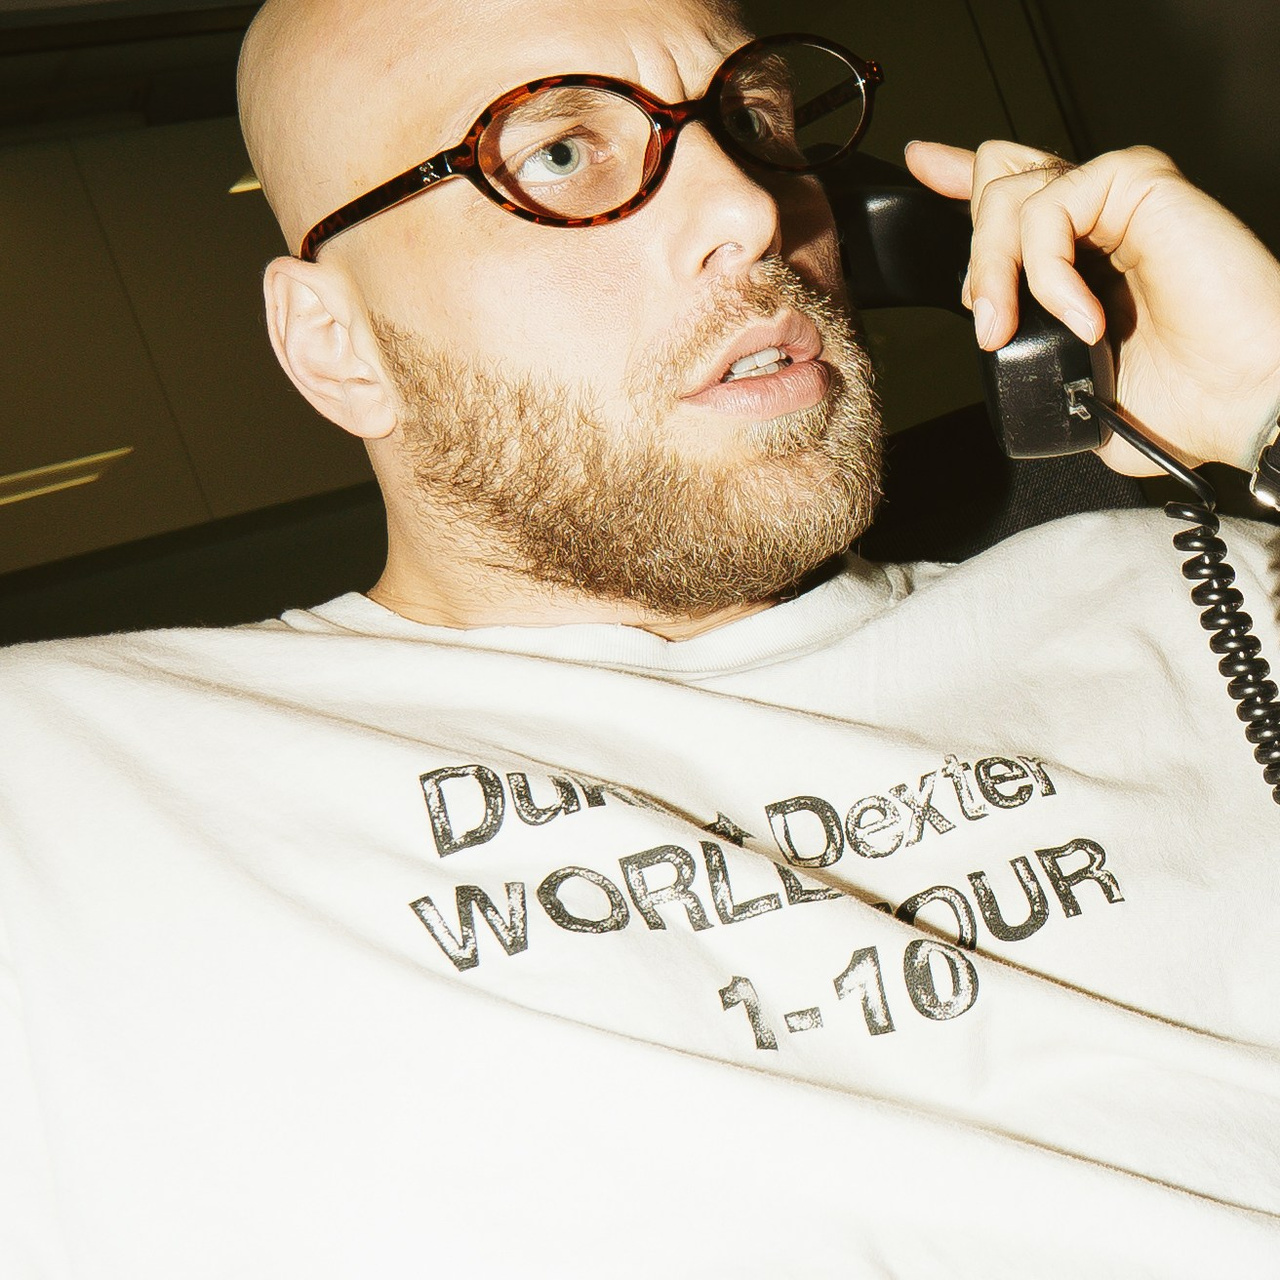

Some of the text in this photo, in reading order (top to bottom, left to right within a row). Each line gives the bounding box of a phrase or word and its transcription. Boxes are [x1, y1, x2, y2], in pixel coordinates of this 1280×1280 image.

[764, 753, 1057, 868] Dexter
[872, 837, 1126, 950] OUR
[718, 937, 980, 1051] 1-10
